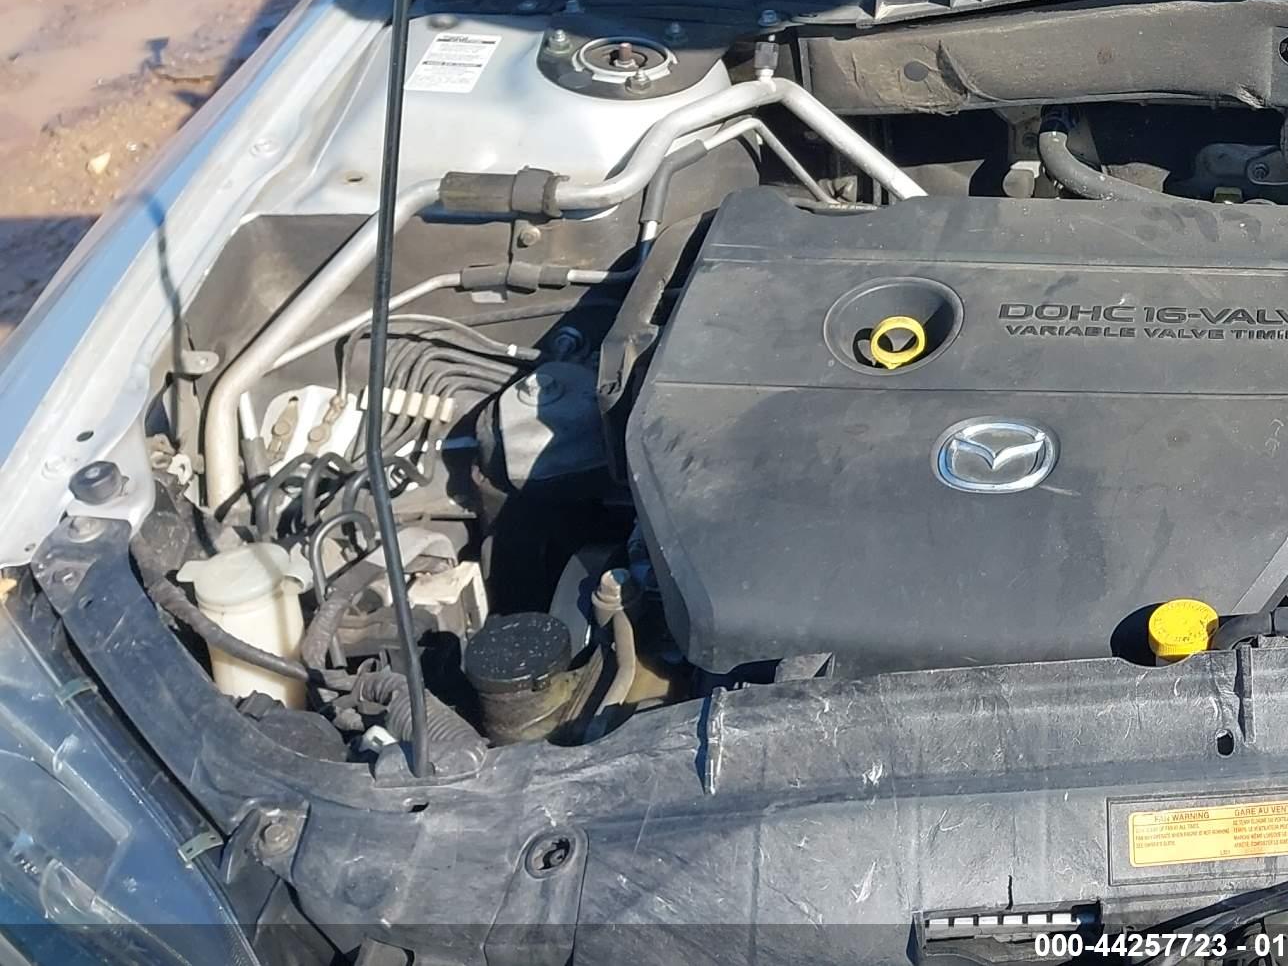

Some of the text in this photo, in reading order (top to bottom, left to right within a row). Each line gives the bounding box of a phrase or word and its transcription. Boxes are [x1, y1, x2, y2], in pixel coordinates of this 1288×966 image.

[998, 303, 1136, 323] DOHC
[1005, 325, 1136, 338] VARIABLE
[1144, 327, 1225, 340] VALVE
[1171, 812, 1210, 821] WARNING
[1235, 807, 1256, 816] GARE
